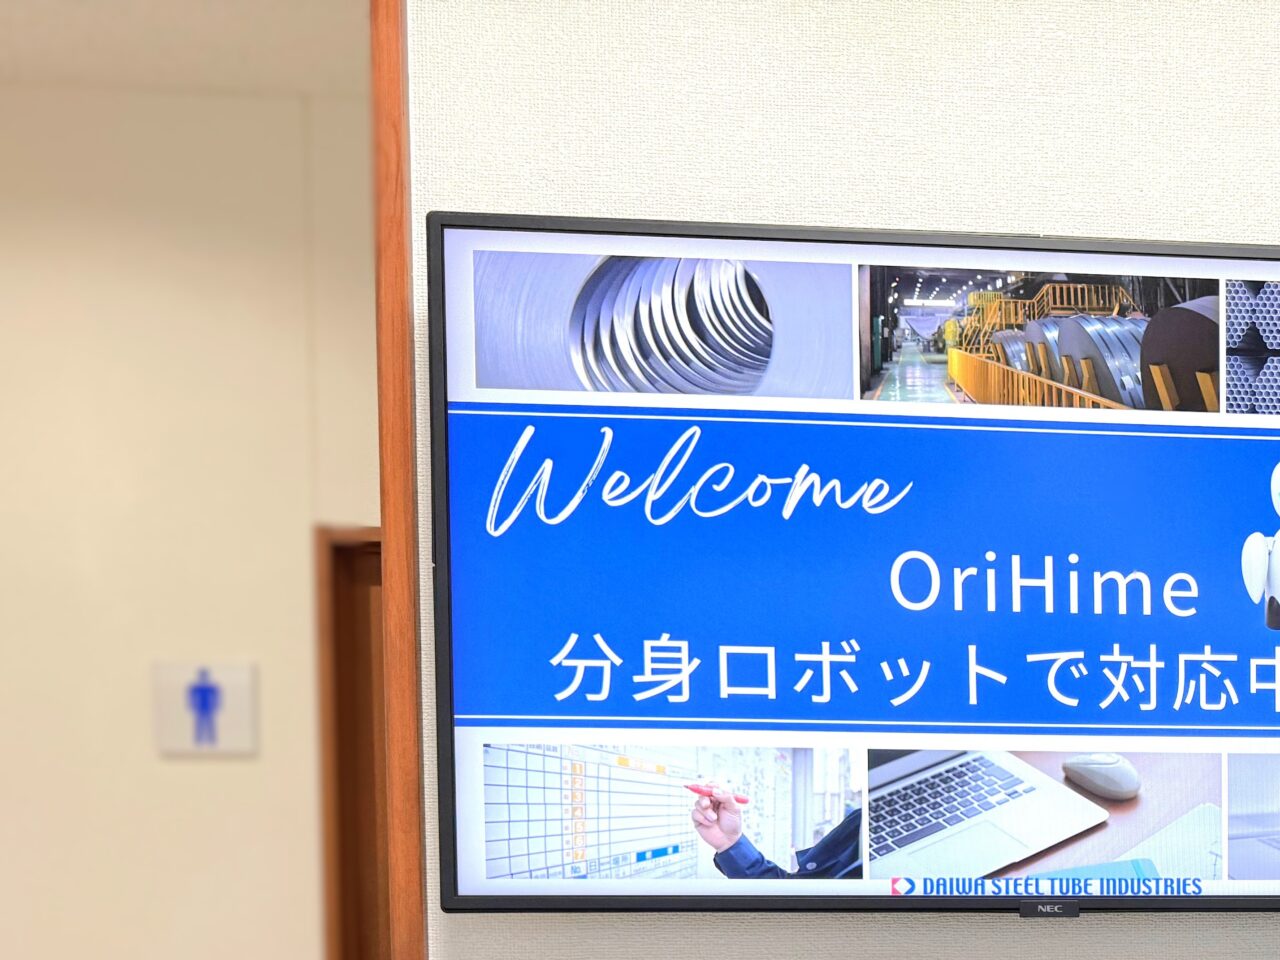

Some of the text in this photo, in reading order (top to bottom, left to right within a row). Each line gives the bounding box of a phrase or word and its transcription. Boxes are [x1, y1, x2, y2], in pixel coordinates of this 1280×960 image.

[485, 425, 913, 538] Welcome
[889, 549, 1199, 617] OriHime
[922, 877, 1202, 895] DAIWA STEEL TUBE INDUSTRIES
[1037, 904, 1063, 913] NEC
